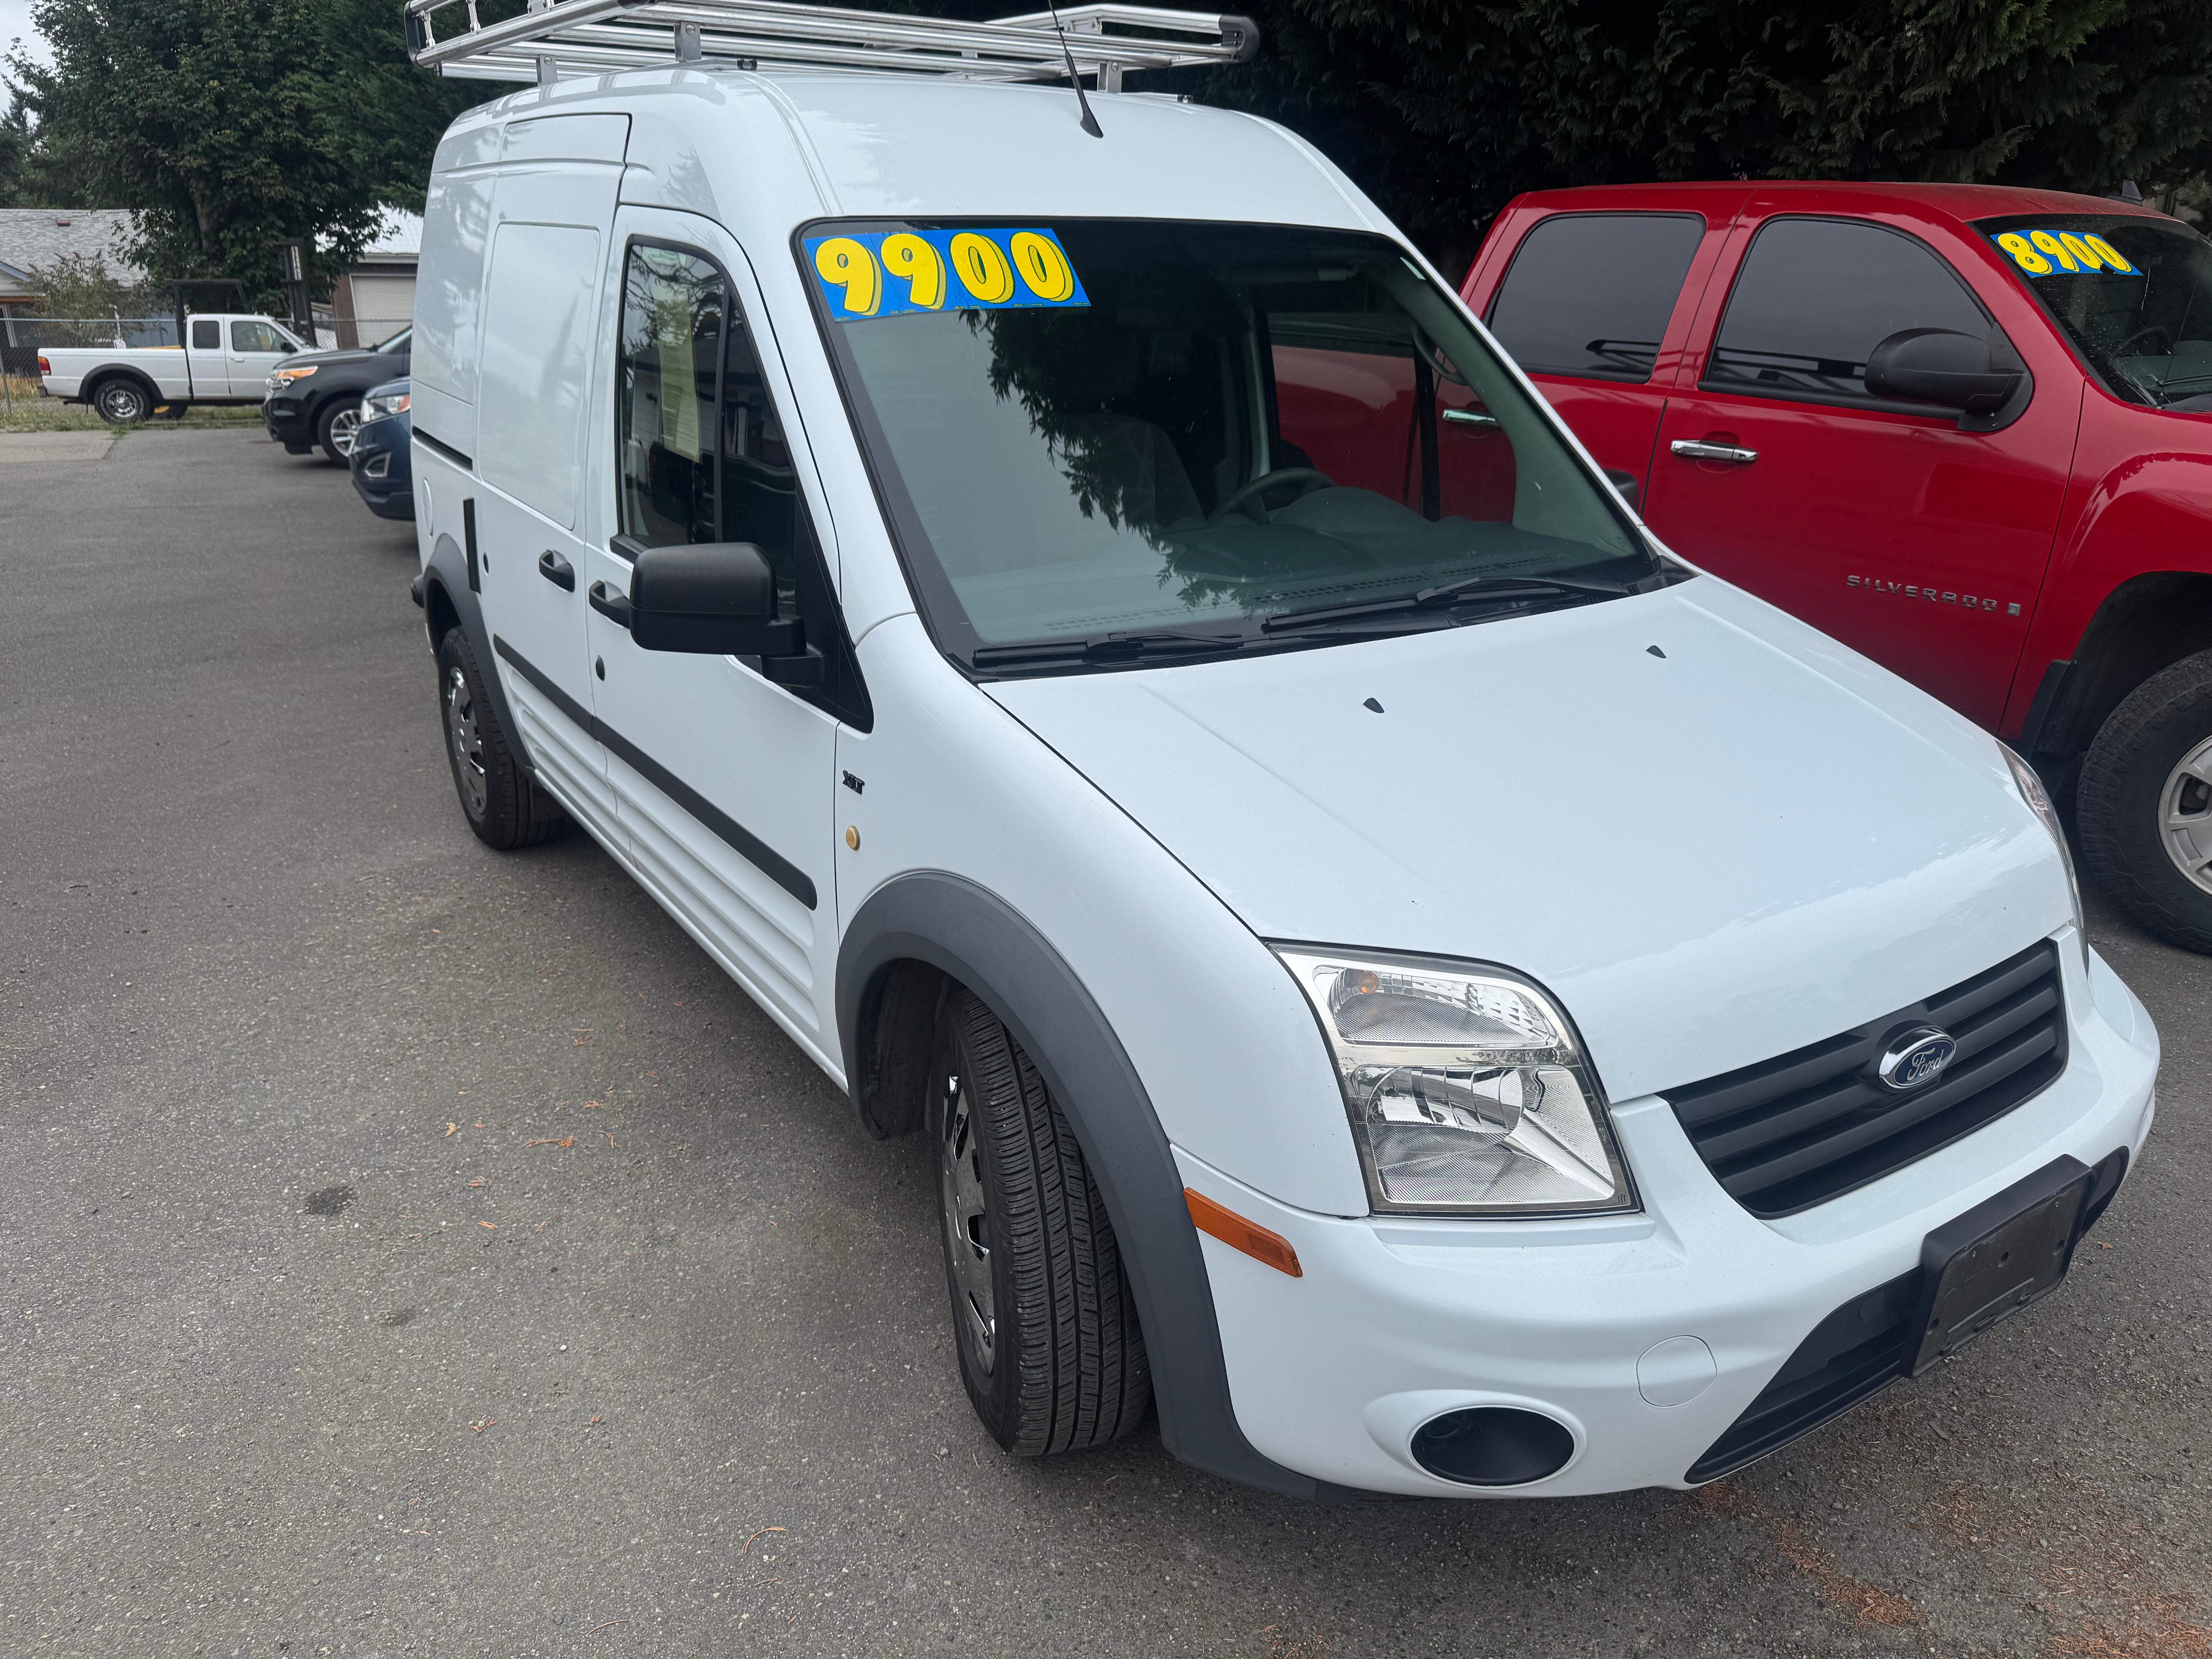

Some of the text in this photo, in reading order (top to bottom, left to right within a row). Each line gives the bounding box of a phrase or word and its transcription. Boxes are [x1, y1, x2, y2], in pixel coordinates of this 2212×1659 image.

[1997, 230, 2132, 275] 8900
[815, 231, 1075, 316] 9900
[1846, 575, 1997, 612] SILVERADO
[1906, 1047, 1944, 1081] Ford
